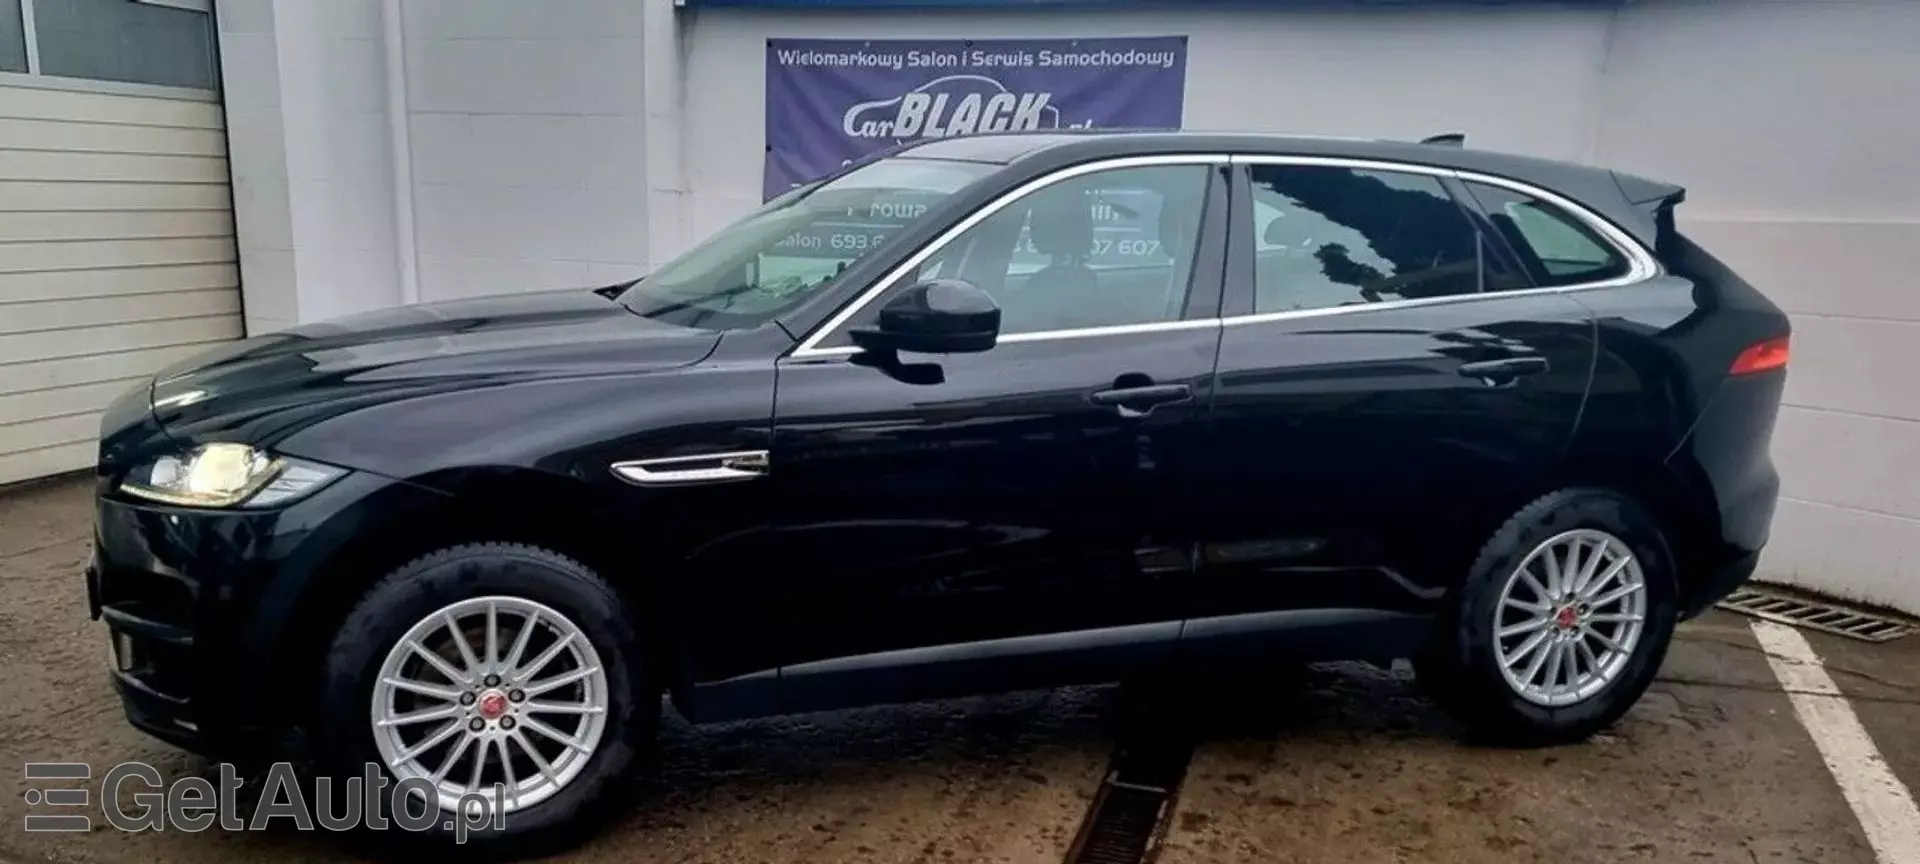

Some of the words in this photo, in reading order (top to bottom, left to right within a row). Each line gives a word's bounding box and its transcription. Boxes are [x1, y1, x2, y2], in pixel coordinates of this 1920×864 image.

[777, 49, 902, 70] Wielomarkowy
[907, 51, 957, 67] Salon
[962, 51, 967, 67] i
[971, 50, 1034, 67] Serwis
[1039, 48, 1175, 68] Samochodowy
[830, 233, 868, 249] 693
[1118, 239, 1161, 257] 607
